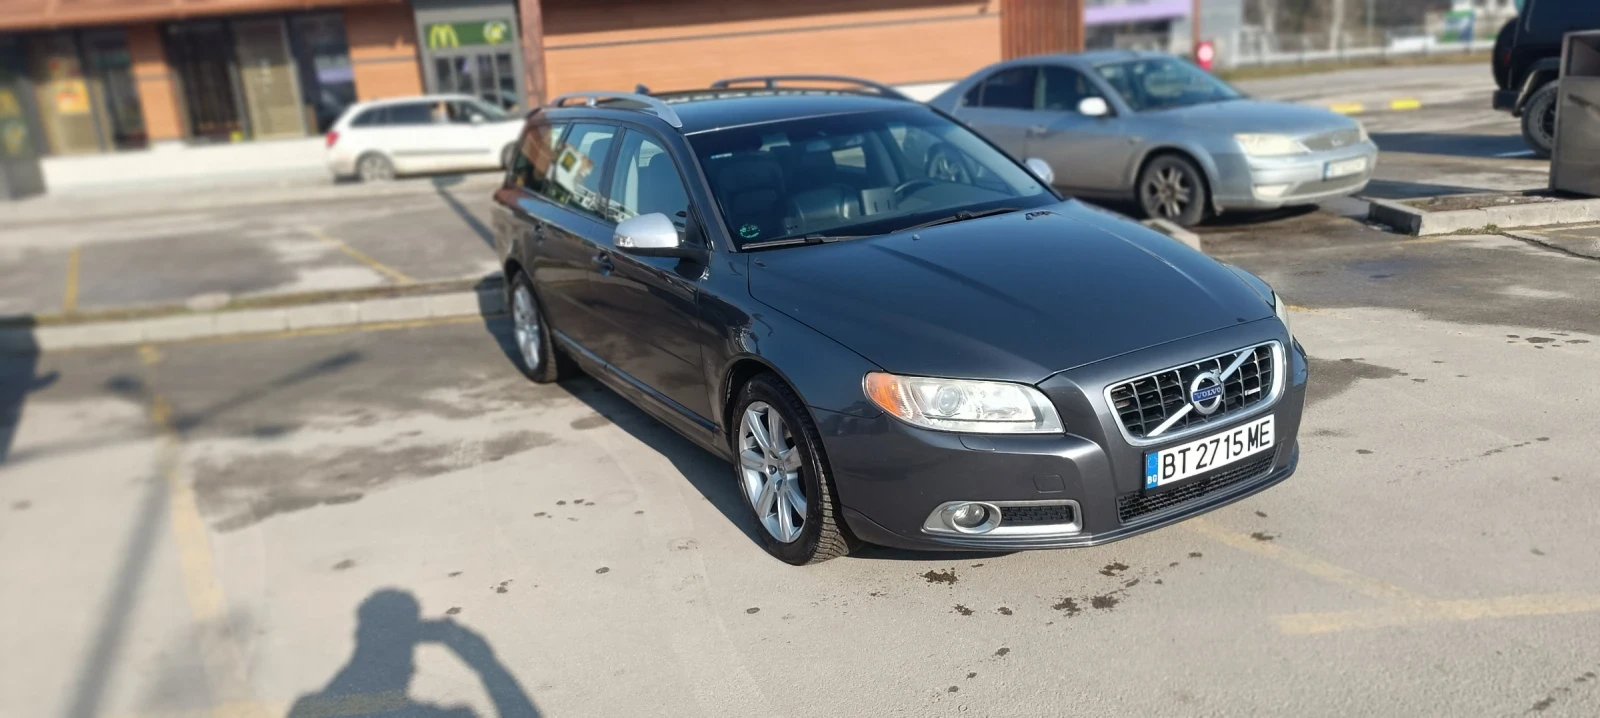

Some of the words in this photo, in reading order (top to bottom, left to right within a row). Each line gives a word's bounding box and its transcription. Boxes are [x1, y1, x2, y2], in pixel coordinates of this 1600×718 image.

[1194, 387, 1221, 399] VOLVO
[1162, 447, 1191, 480] BT
[1195, 430, 1244, 470] 2715
[1247, 420, 1270, 452] ME
[1147, 474, 1158, 485] BG
